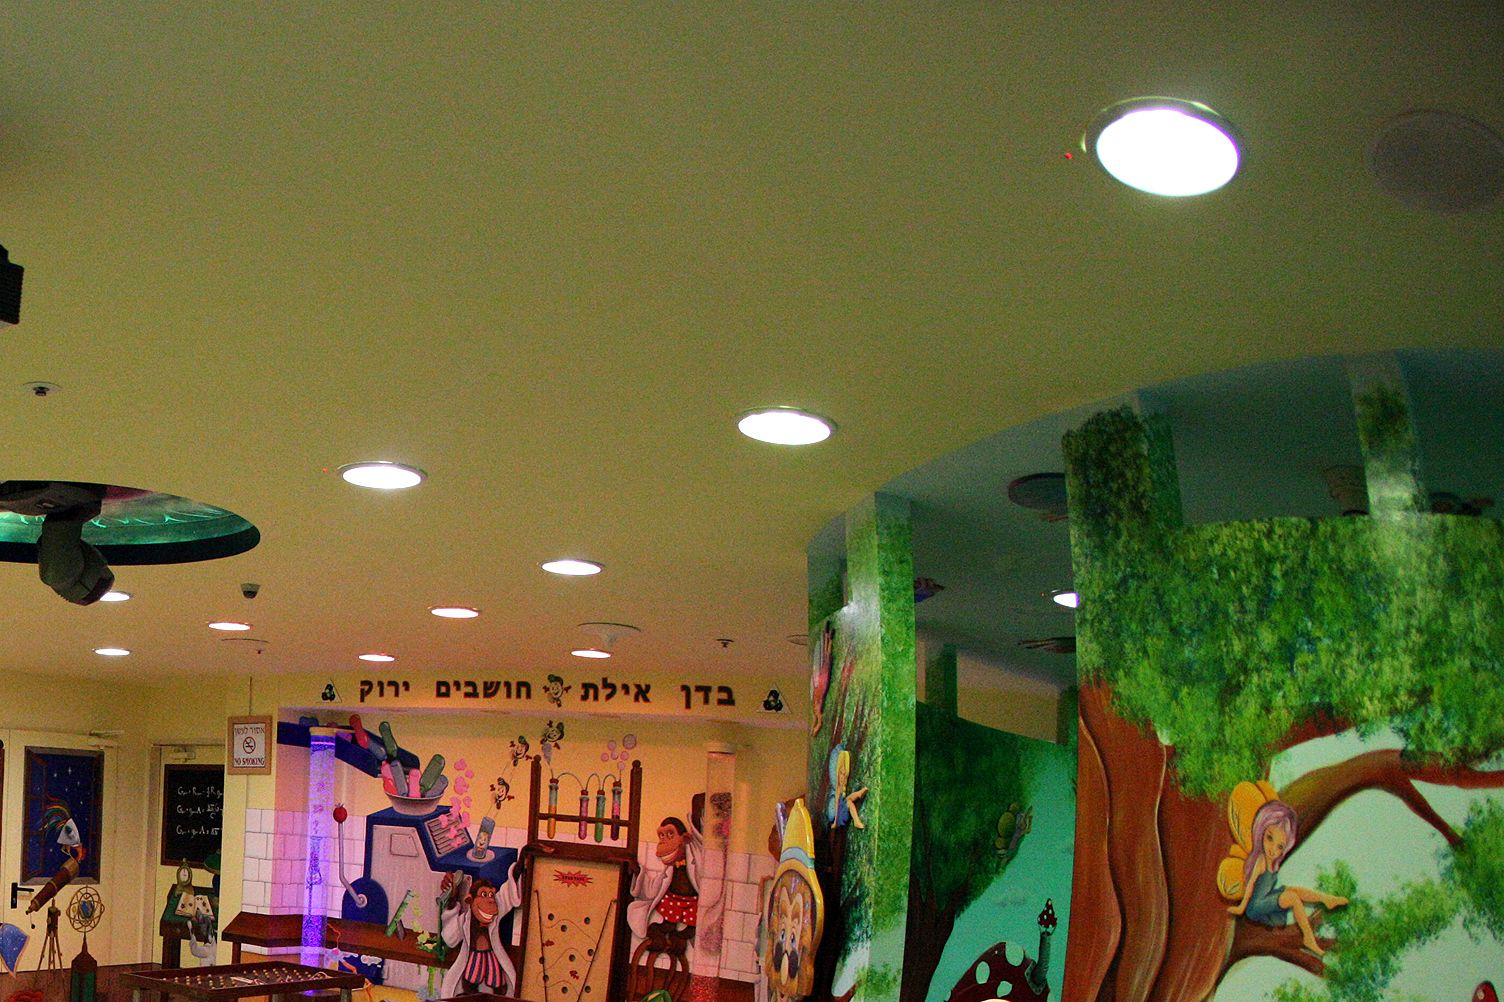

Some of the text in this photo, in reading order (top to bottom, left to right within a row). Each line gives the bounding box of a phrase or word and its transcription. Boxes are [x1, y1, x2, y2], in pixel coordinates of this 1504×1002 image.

[359, 677, 736, 709] בדן אילת חושבים ירוק
